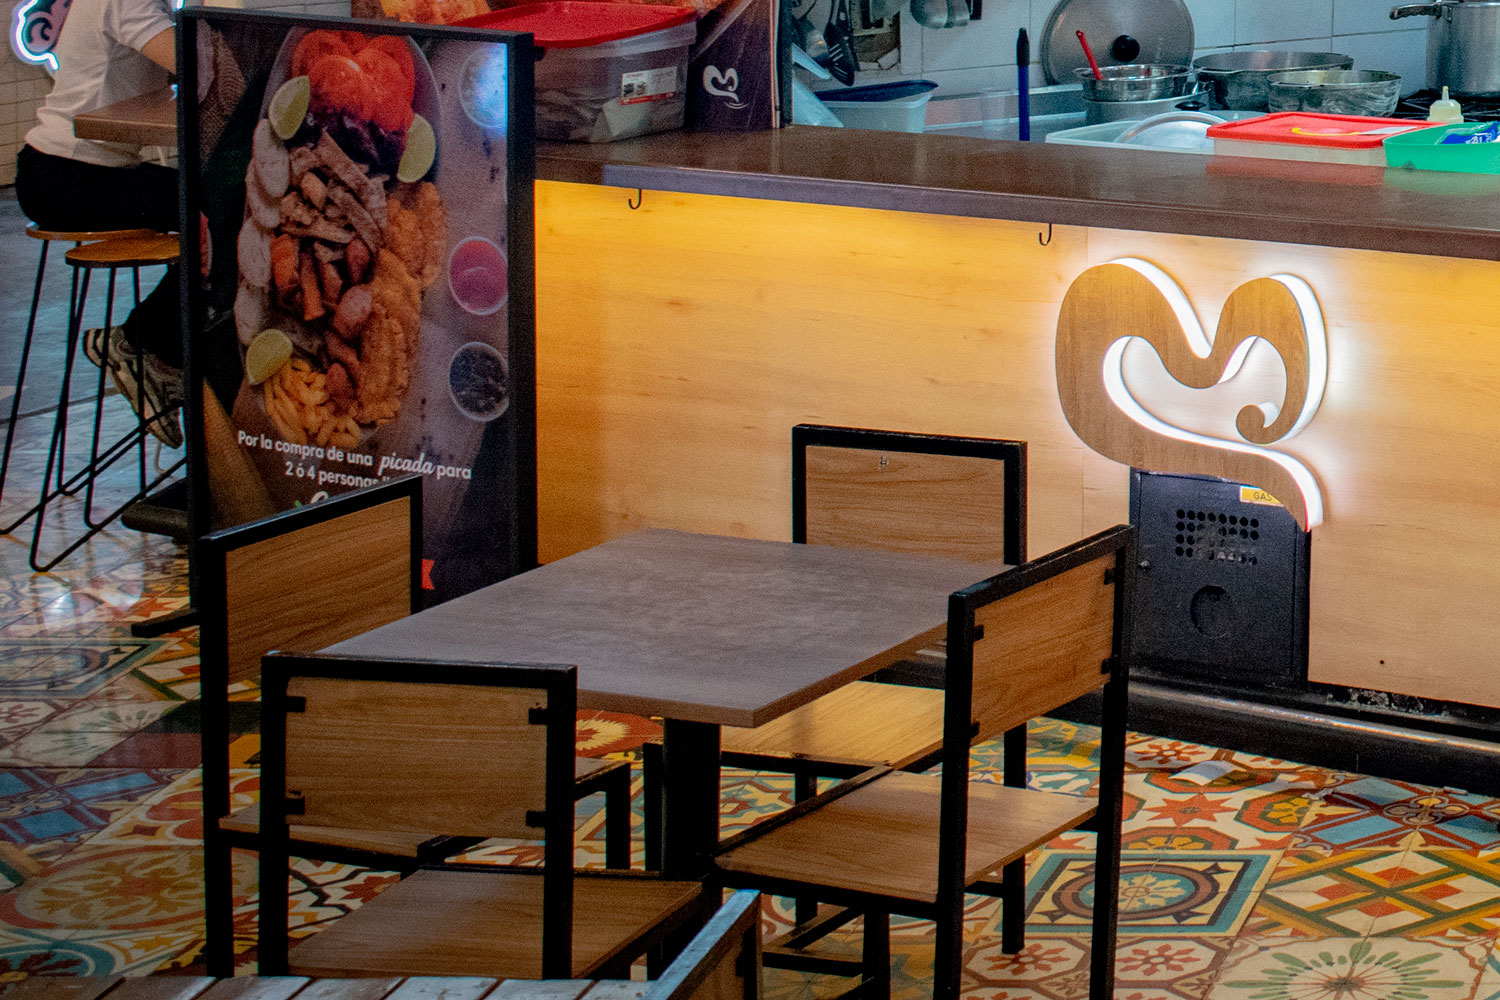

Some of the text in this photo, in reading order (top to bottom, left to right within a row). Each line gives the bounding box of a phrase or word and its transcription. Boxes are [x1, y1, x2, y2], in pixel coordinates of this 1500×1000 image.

[238, 430, 472, 480] Por la compra de una picada para
[285, 461, 294, 476] 2
[296, 461, 305, 478] ó
[307, 464, 317, 479] 4
[1254, 491, 1273, 502] GAS
